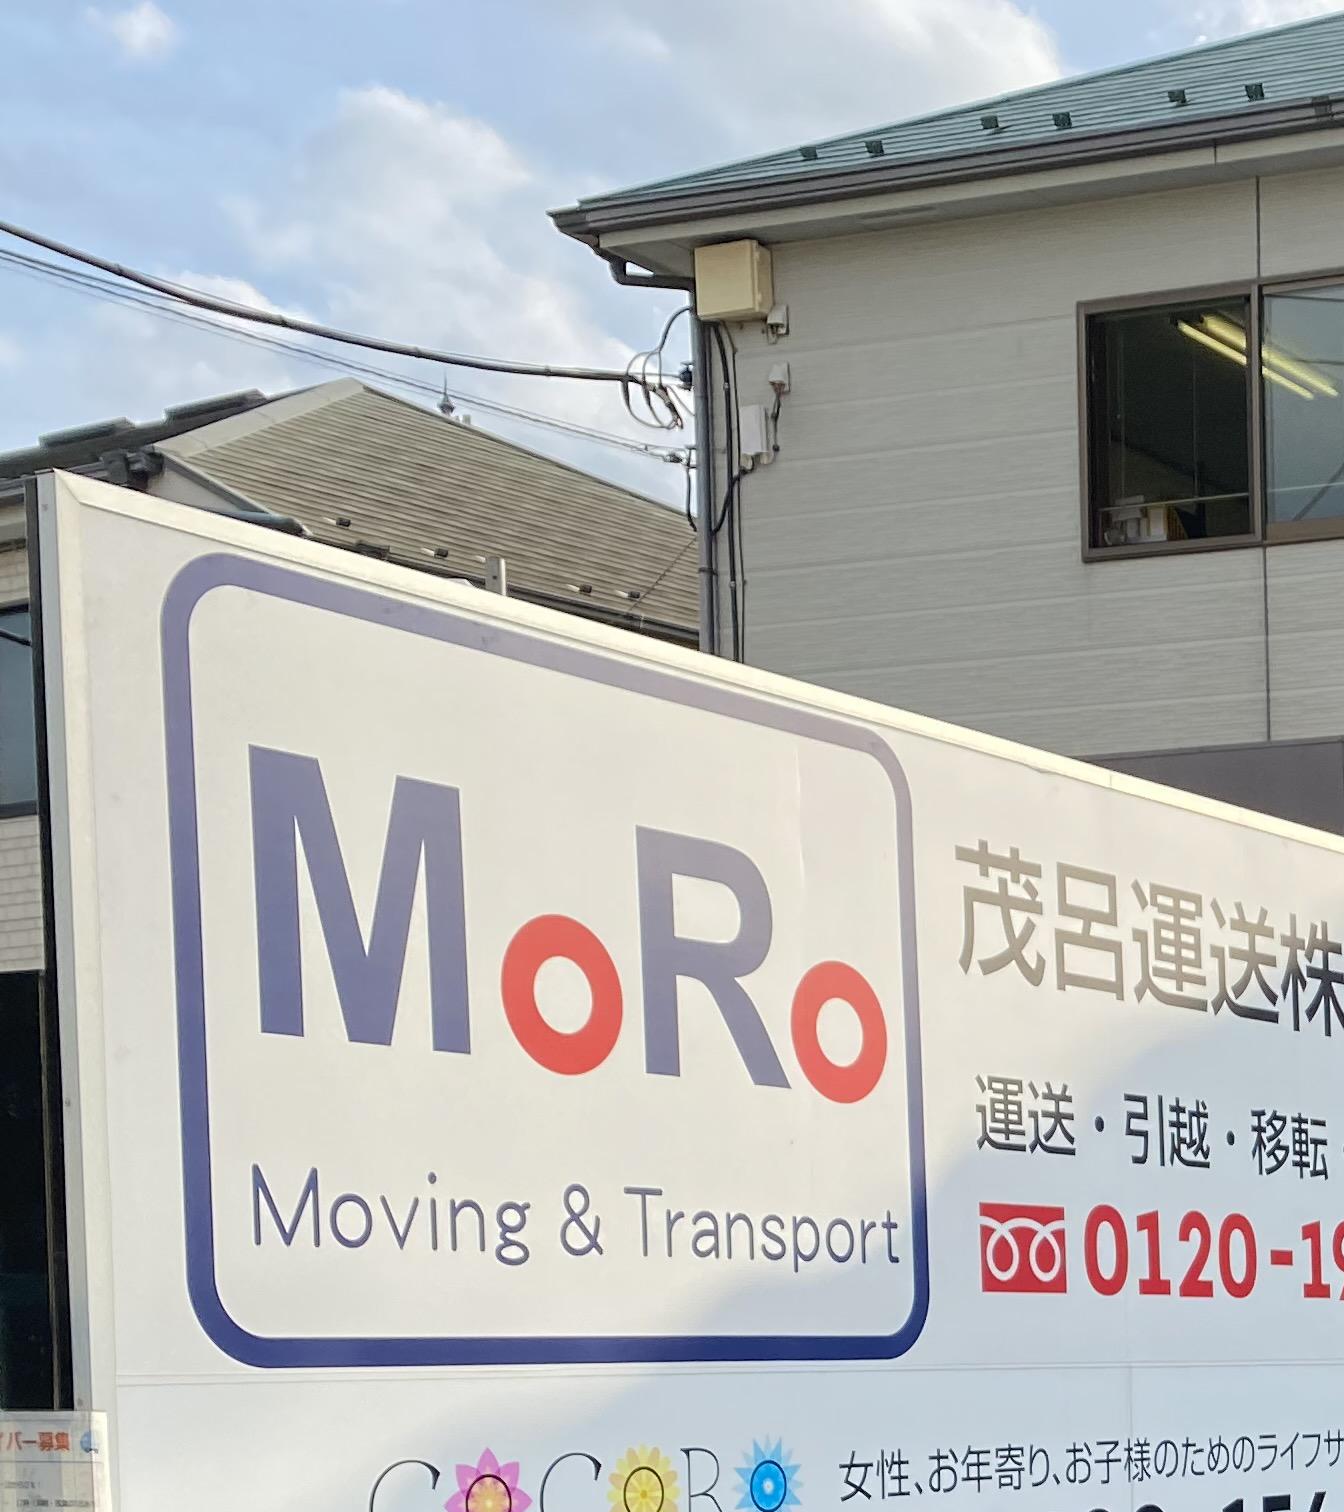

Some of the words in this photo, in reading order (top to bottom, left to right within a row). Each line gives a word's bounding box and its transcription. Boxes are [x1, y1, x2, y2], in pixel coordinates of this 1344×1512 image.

[248, 744, 888, 1105] MoRo
[251, 1162, 532, 1268] Moving
[560, 1183, 604, 1258] &
[623, 1186, 902, 1275] Transport
